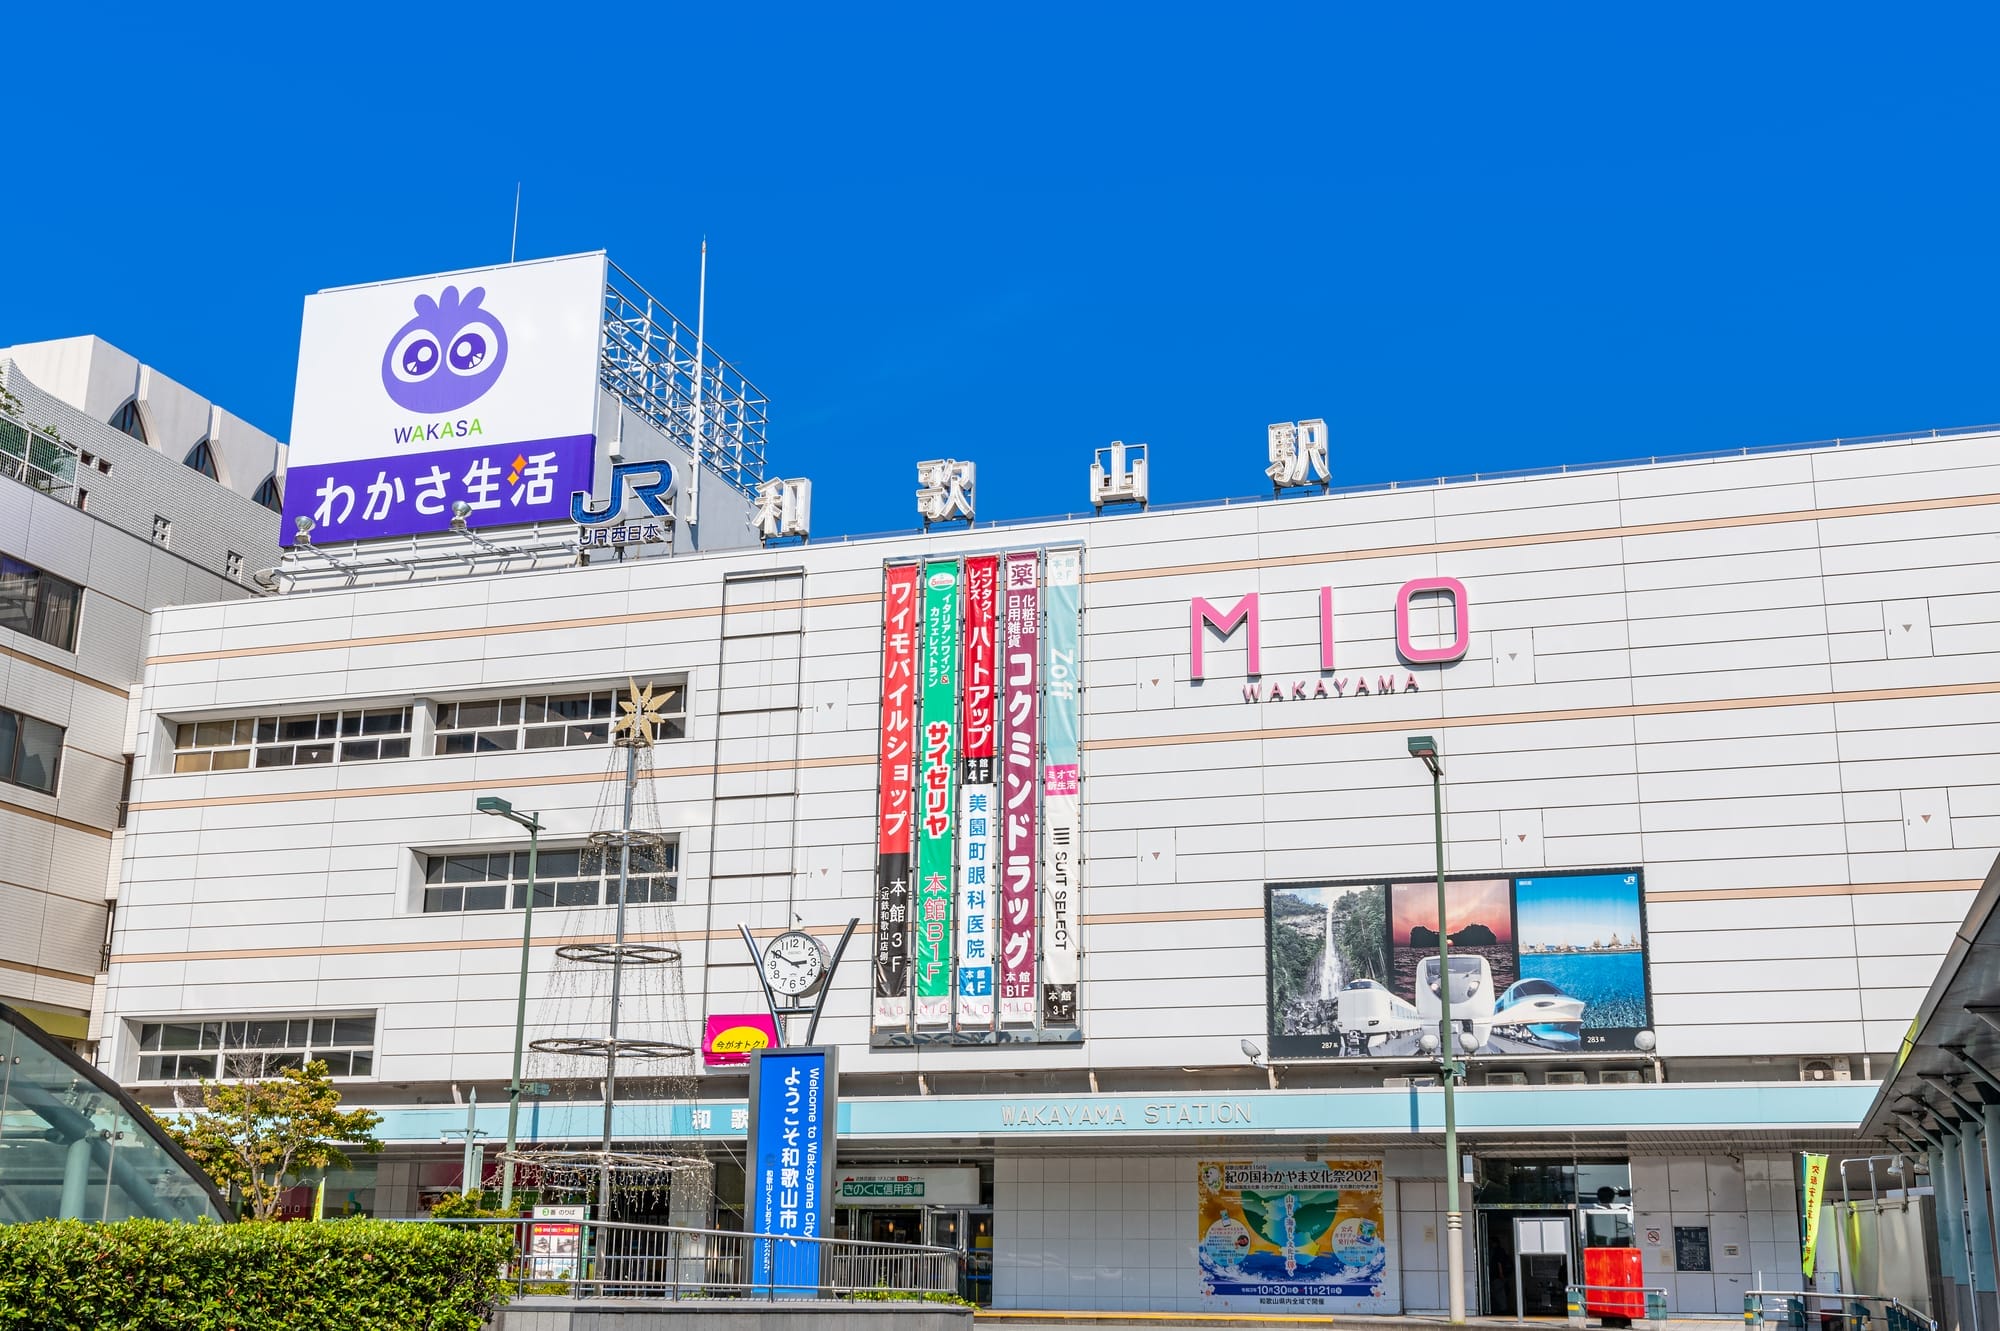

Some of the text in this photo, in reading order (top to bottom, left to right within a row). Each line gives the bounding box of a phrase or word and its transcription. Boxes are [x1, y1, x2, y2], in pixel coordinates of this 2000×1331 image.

[393, 418, 483, 444] WAKASA
[313, 452, 559, 527] わかさ生活
[570, 459, 678, 527] JR
[580, 523, 659, 545] JR西日本
[1011, 563, 1033, 587] 薬
[970, 568, 981, 600] レンズ
[981, 567, 992, 623] コンタクト
[1008, 594, 1022, 649] 日用雑貨
[1022, 594, 1035, 634] 化粧品
[1190, 576, 1470, 679] MIO
[928, 607, 940, 688] カフェレストラン
[1051, 648, 1075, 701] Zoff
[967, 626, 991, 749] ハートアップ
[1243, 672, 1420, 704] WAKAYAMA
[885, 581, 911, 836] ワイモバイルショップ
[924, 722, 950, 838] サイゼリヤ
[967, 769, 989, 782] 4F
[1047, 769, 1076, 780] ミオで
[1047, 780, 1077, 791] 新生活
[1005, 652, 1033, 969] コクミンドラッグ
[966, 794, 987, 959] 美園町眼科医院
[1054, 851, 1068, 950] SUIT SELECT
[923, 872, 947, 982] 本館B1F
[781, 941, 788, 951] 11
[790, 939, 799, 948] 12
[802, 941, 806, 950] 1
[807, 947, 815, 957] 2
[770, 960, 777, 970] 9
[810, 958, 817, 967] 3
[773, 970, 780, 979] 8
[806, 969, 813, 977] 4
[1005, 971, 1030, 983] 本館
[780, 977, 787, 987] 7
[789, 979, 796, 989] 6
[799, 976, 806, 986] 5
[965, 980, 986, 996] 4F
[1006, 984, 1030, 998] B1F
[1048, 991, 1072, 1002] 本館
[919, 1003, 948, 1014] MIO
[961, 1004, 990, 1014] MIO
[1003, 1002, 1033, 1013] MIO
[1052, 1005, 1069, 1015] 3F
[716, 1040, 766, 1050] 今がオトク!
[1000, 1102, 1252, 1126] WAKAYAMA STATION
[803, 1067, 820, 1238] Welcome to Wakayama City
[1225, 1170, 1379, 1184] 紀の国わかやま文化祭2021
